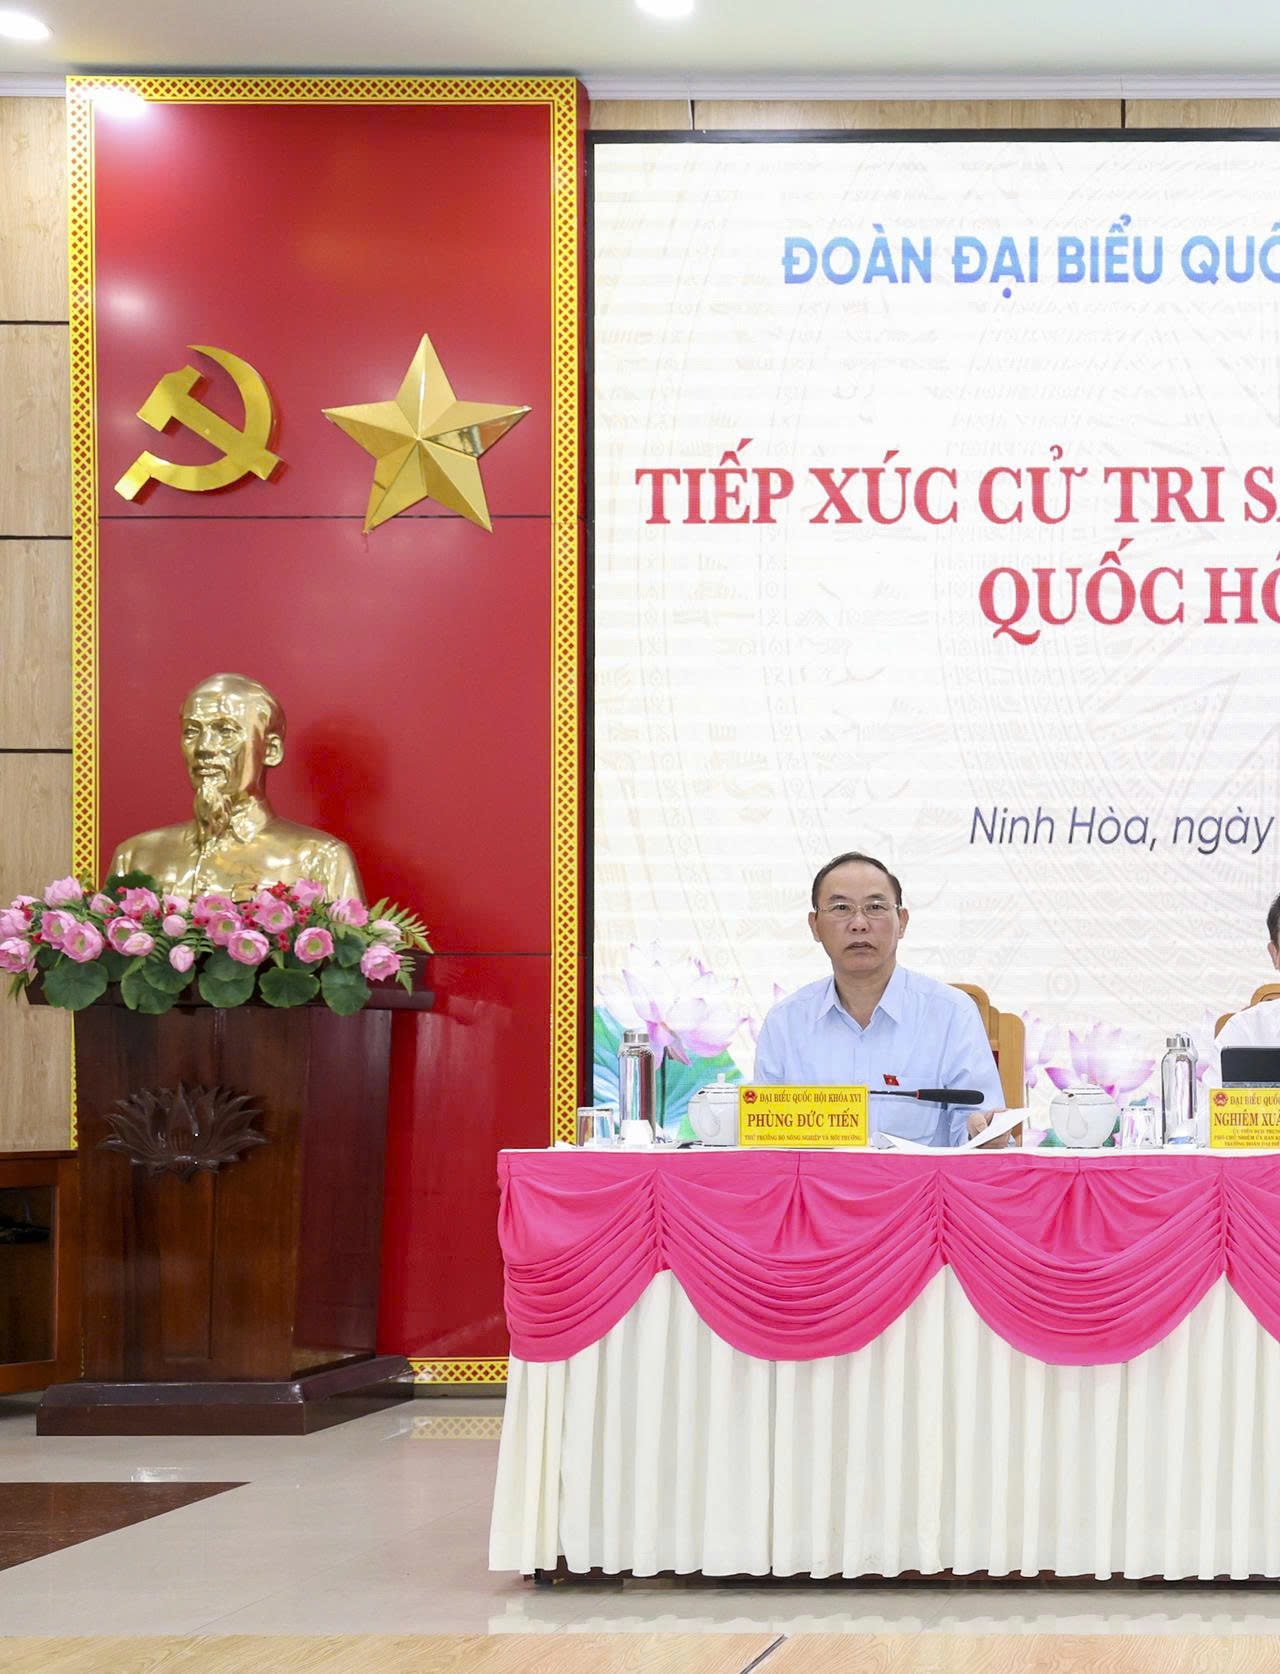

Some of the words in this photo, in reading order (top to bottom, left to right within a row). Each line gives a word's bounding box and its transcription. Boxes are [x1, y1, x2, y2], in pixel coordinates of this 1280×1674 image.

[784, 224, 931, 284] ĐOÀN
[953, 237, 1037, 298] ĐẠI
[1058, 216, 1162, 283] BIỂU
[637, 439, 792, 523] TIẾP
[812, 451, 957, 524] XÚC
[980, 446, 1088, 524] CỬ
[1104, 467, 1224, 522] TRI
[980, 538, 1184, 645] QUỐC
[970, 806, 1054, 844] Ninh
[1069, 806, 1156, 852] Hòa,
[1173, 807, 1274, 855] ngày
[747, 1109, 794, 1128] PHÙNG
[797, 1109, 824, 1128] ĐỨC
[828, 1107, 860, 1128] TIẾN
[760, 1093, 772, 1104] ĐẠI
[793, 1090, 810, 1104] QUỐC
[814, 1091, 826, 1104] HỘI
[828, 1091, 848, 1103] KHÓA
[850, 1093, 862, 1103] XVI
